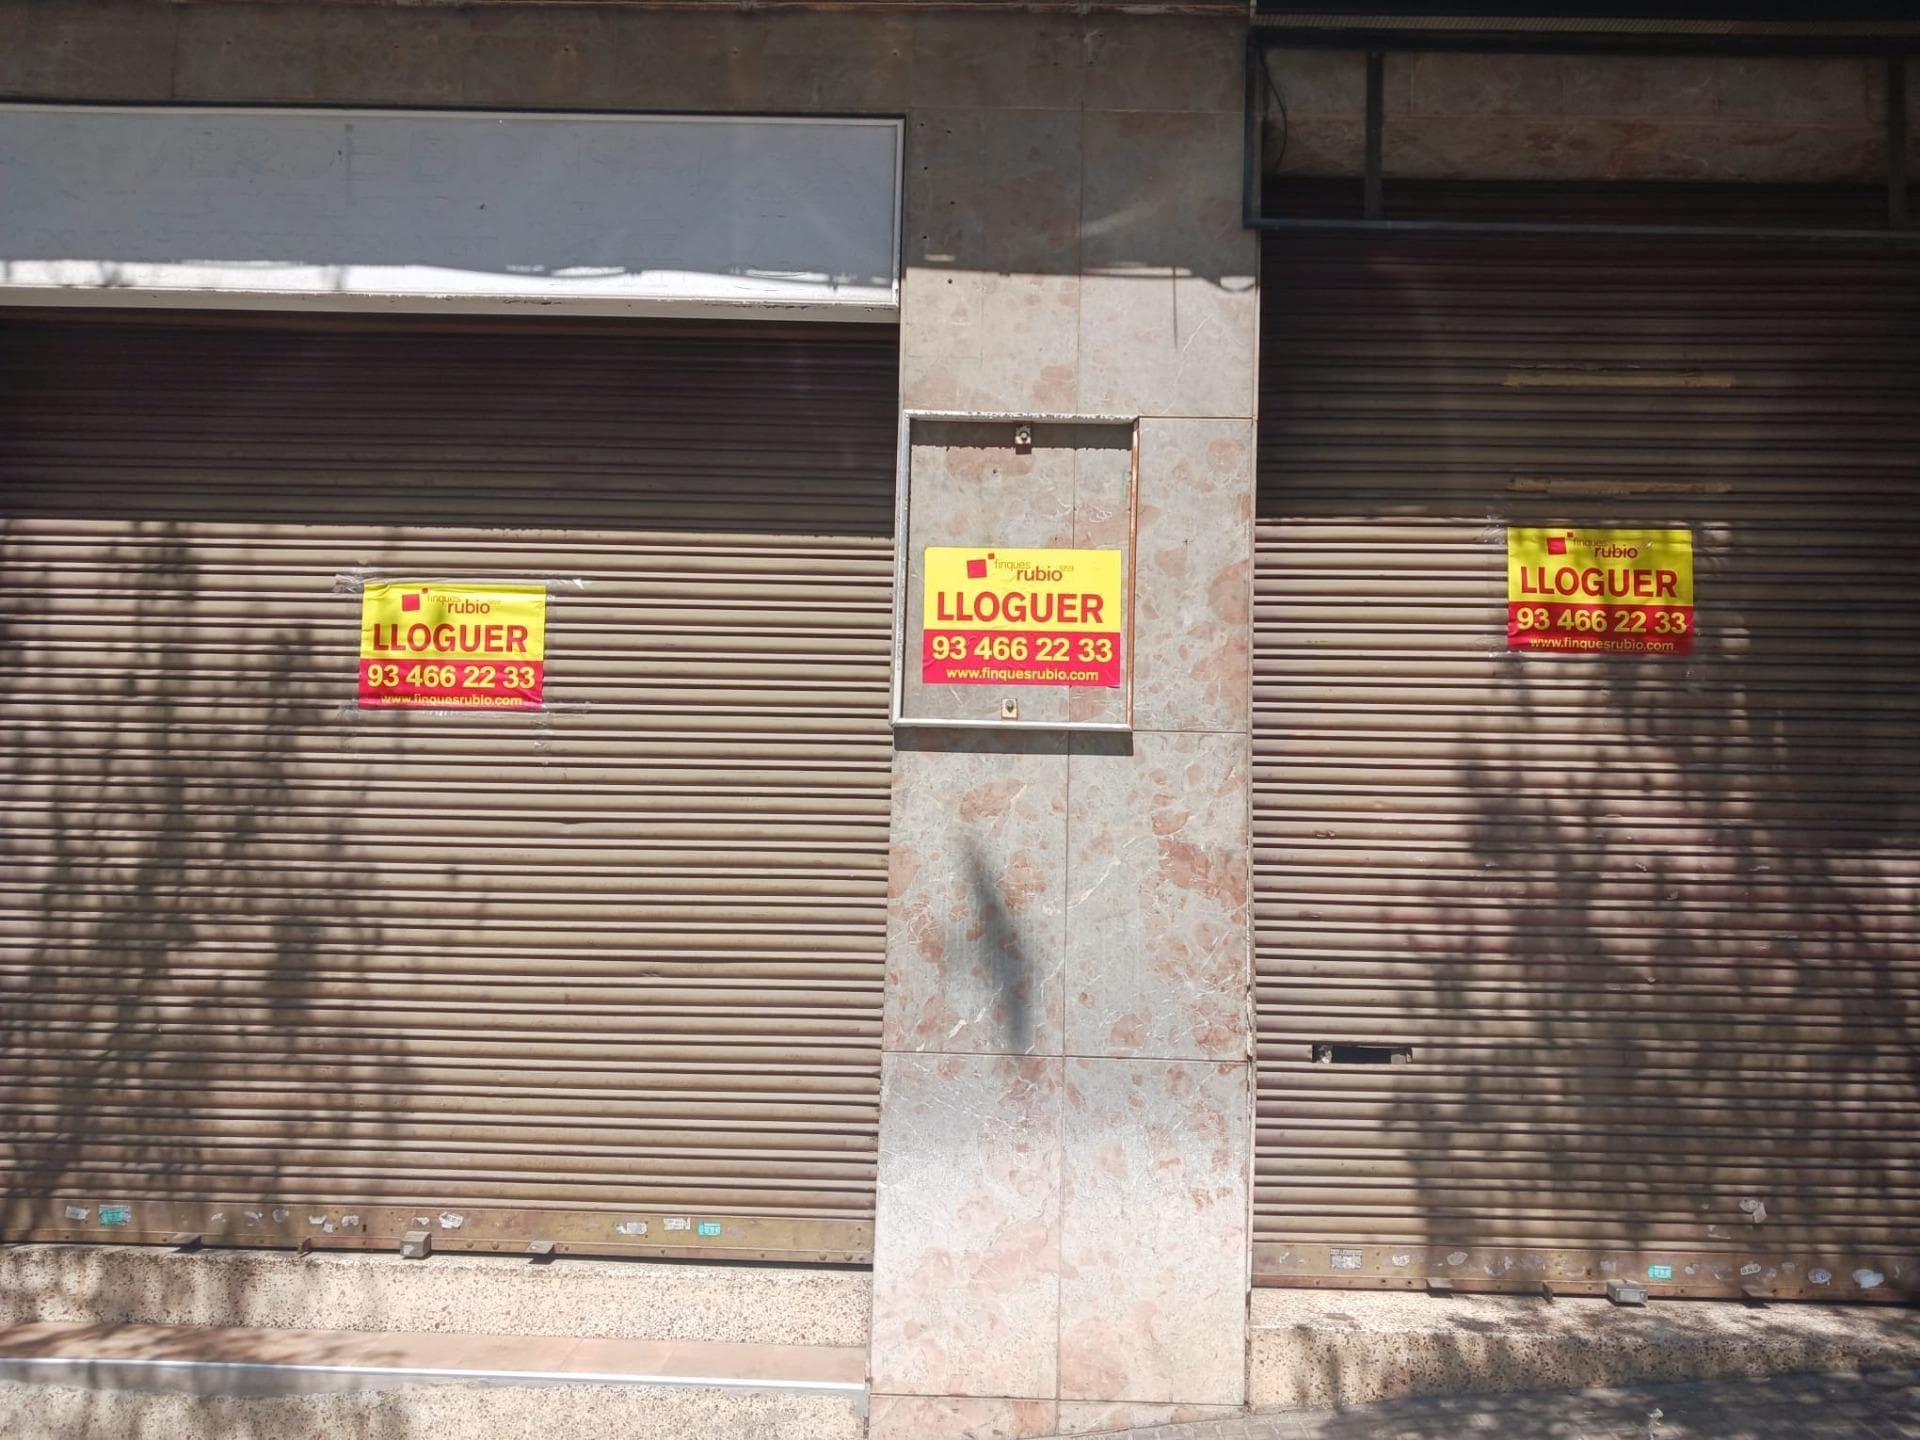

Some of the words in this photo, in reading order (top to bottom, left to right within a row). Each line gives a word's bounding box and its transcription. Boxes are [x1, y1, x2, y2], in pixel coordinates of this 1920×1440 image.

[1594, 544, 1639, 558] rubio
[994, 559, 1031, 572] finques
[1017, 566, 1063, 581] rubio
[1521, 567, 1677, 597] LLOGUER
[447, 599, 490, 614] rubio
[937, 591, 1104, 623] LLOGUER
[1516, 607, 1550, 630] 93
[1557, 608, 1607, 632] 466
[1613, 610, 1647, 633] 22
[1654, 611, 1687, 634] 33
[374, 624, 528, 652] LLOGUER
[1529, 636, 1674, 652] www.finquesrubio.com
[931, 635, 967, 660] 93
[974, 636, 1028, 661] 466
[1035, 637, 1070, 662] 22
[1077, 638, 1113, 663] 33
[367, 664, 399, 687] 93
[405, 665, 456, 688] 466
[462, 665, 495, 688] 22
[503, 666, 536, 689] 33
[946, 667, 1099, 681] www.finquesrubio.com
[382, 694, 522, 706] www.finquesrubio.com
